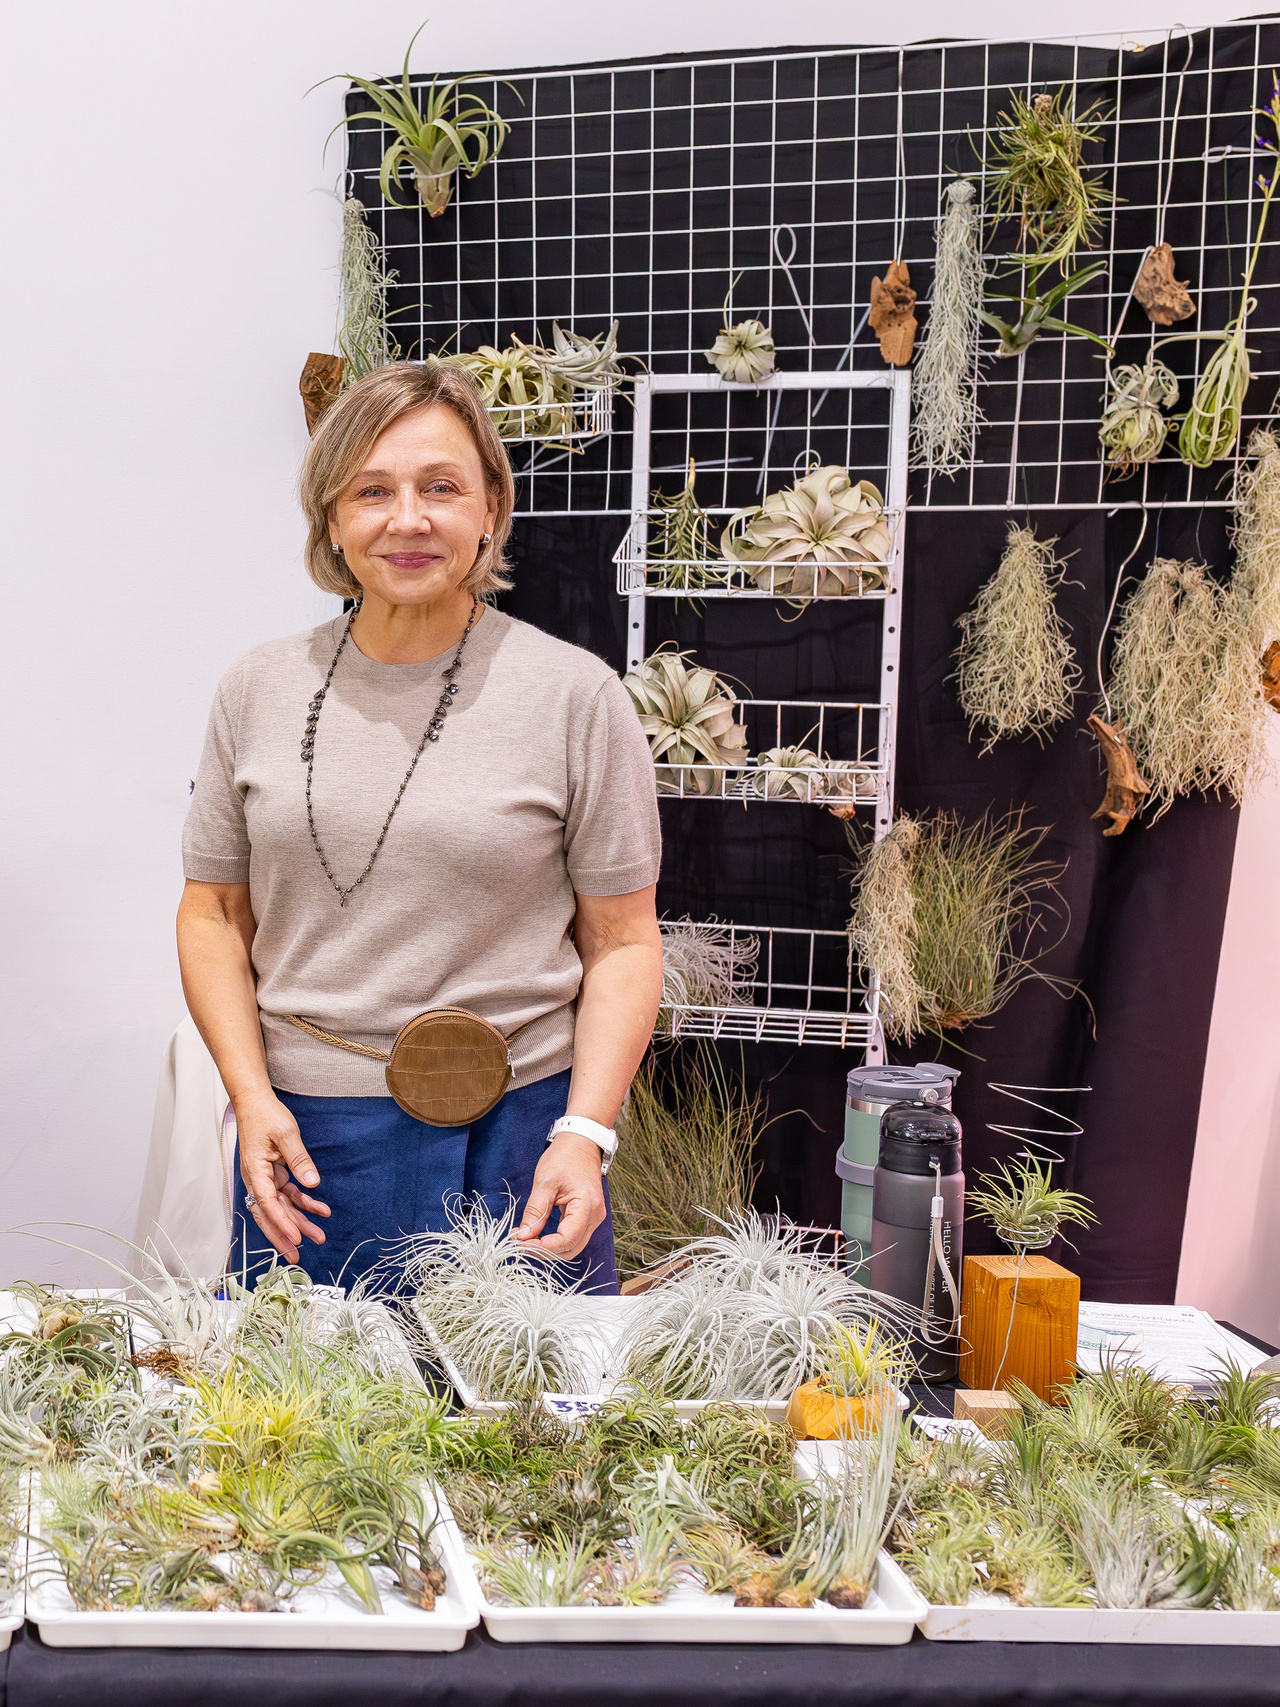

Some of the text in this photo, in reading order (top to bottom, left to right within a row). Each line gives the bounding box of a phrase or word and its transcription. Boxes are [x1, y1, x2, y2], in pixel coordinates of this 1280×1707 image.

[941, 1220, 952, 1293] HELLO WER
[550, 1400, 602, 1412] 350
[928, 1423, 974, 1437] 300
